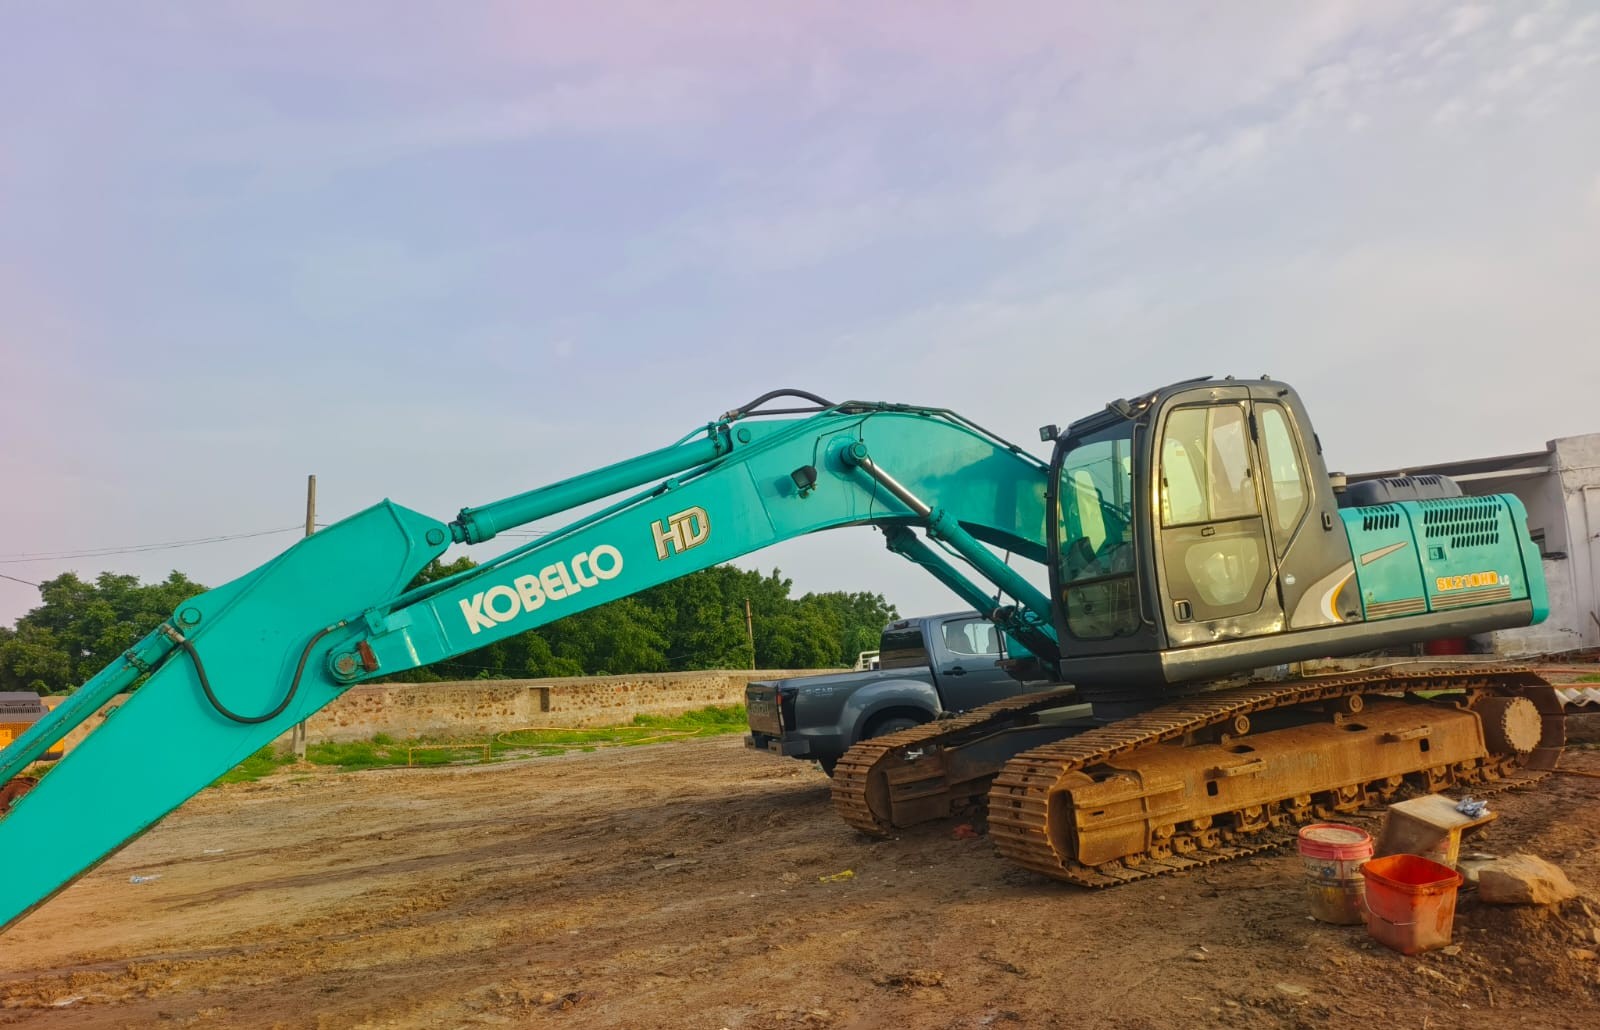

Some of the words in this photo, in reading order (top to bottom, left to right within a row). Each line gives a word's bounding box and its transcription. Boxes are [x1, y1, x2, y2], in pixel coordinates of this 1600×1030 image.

[651, 505, 711, 561] HD
[458, 544, 624, 635] KOBELCO
[1436, 570, 1498, 592] SK210HD
